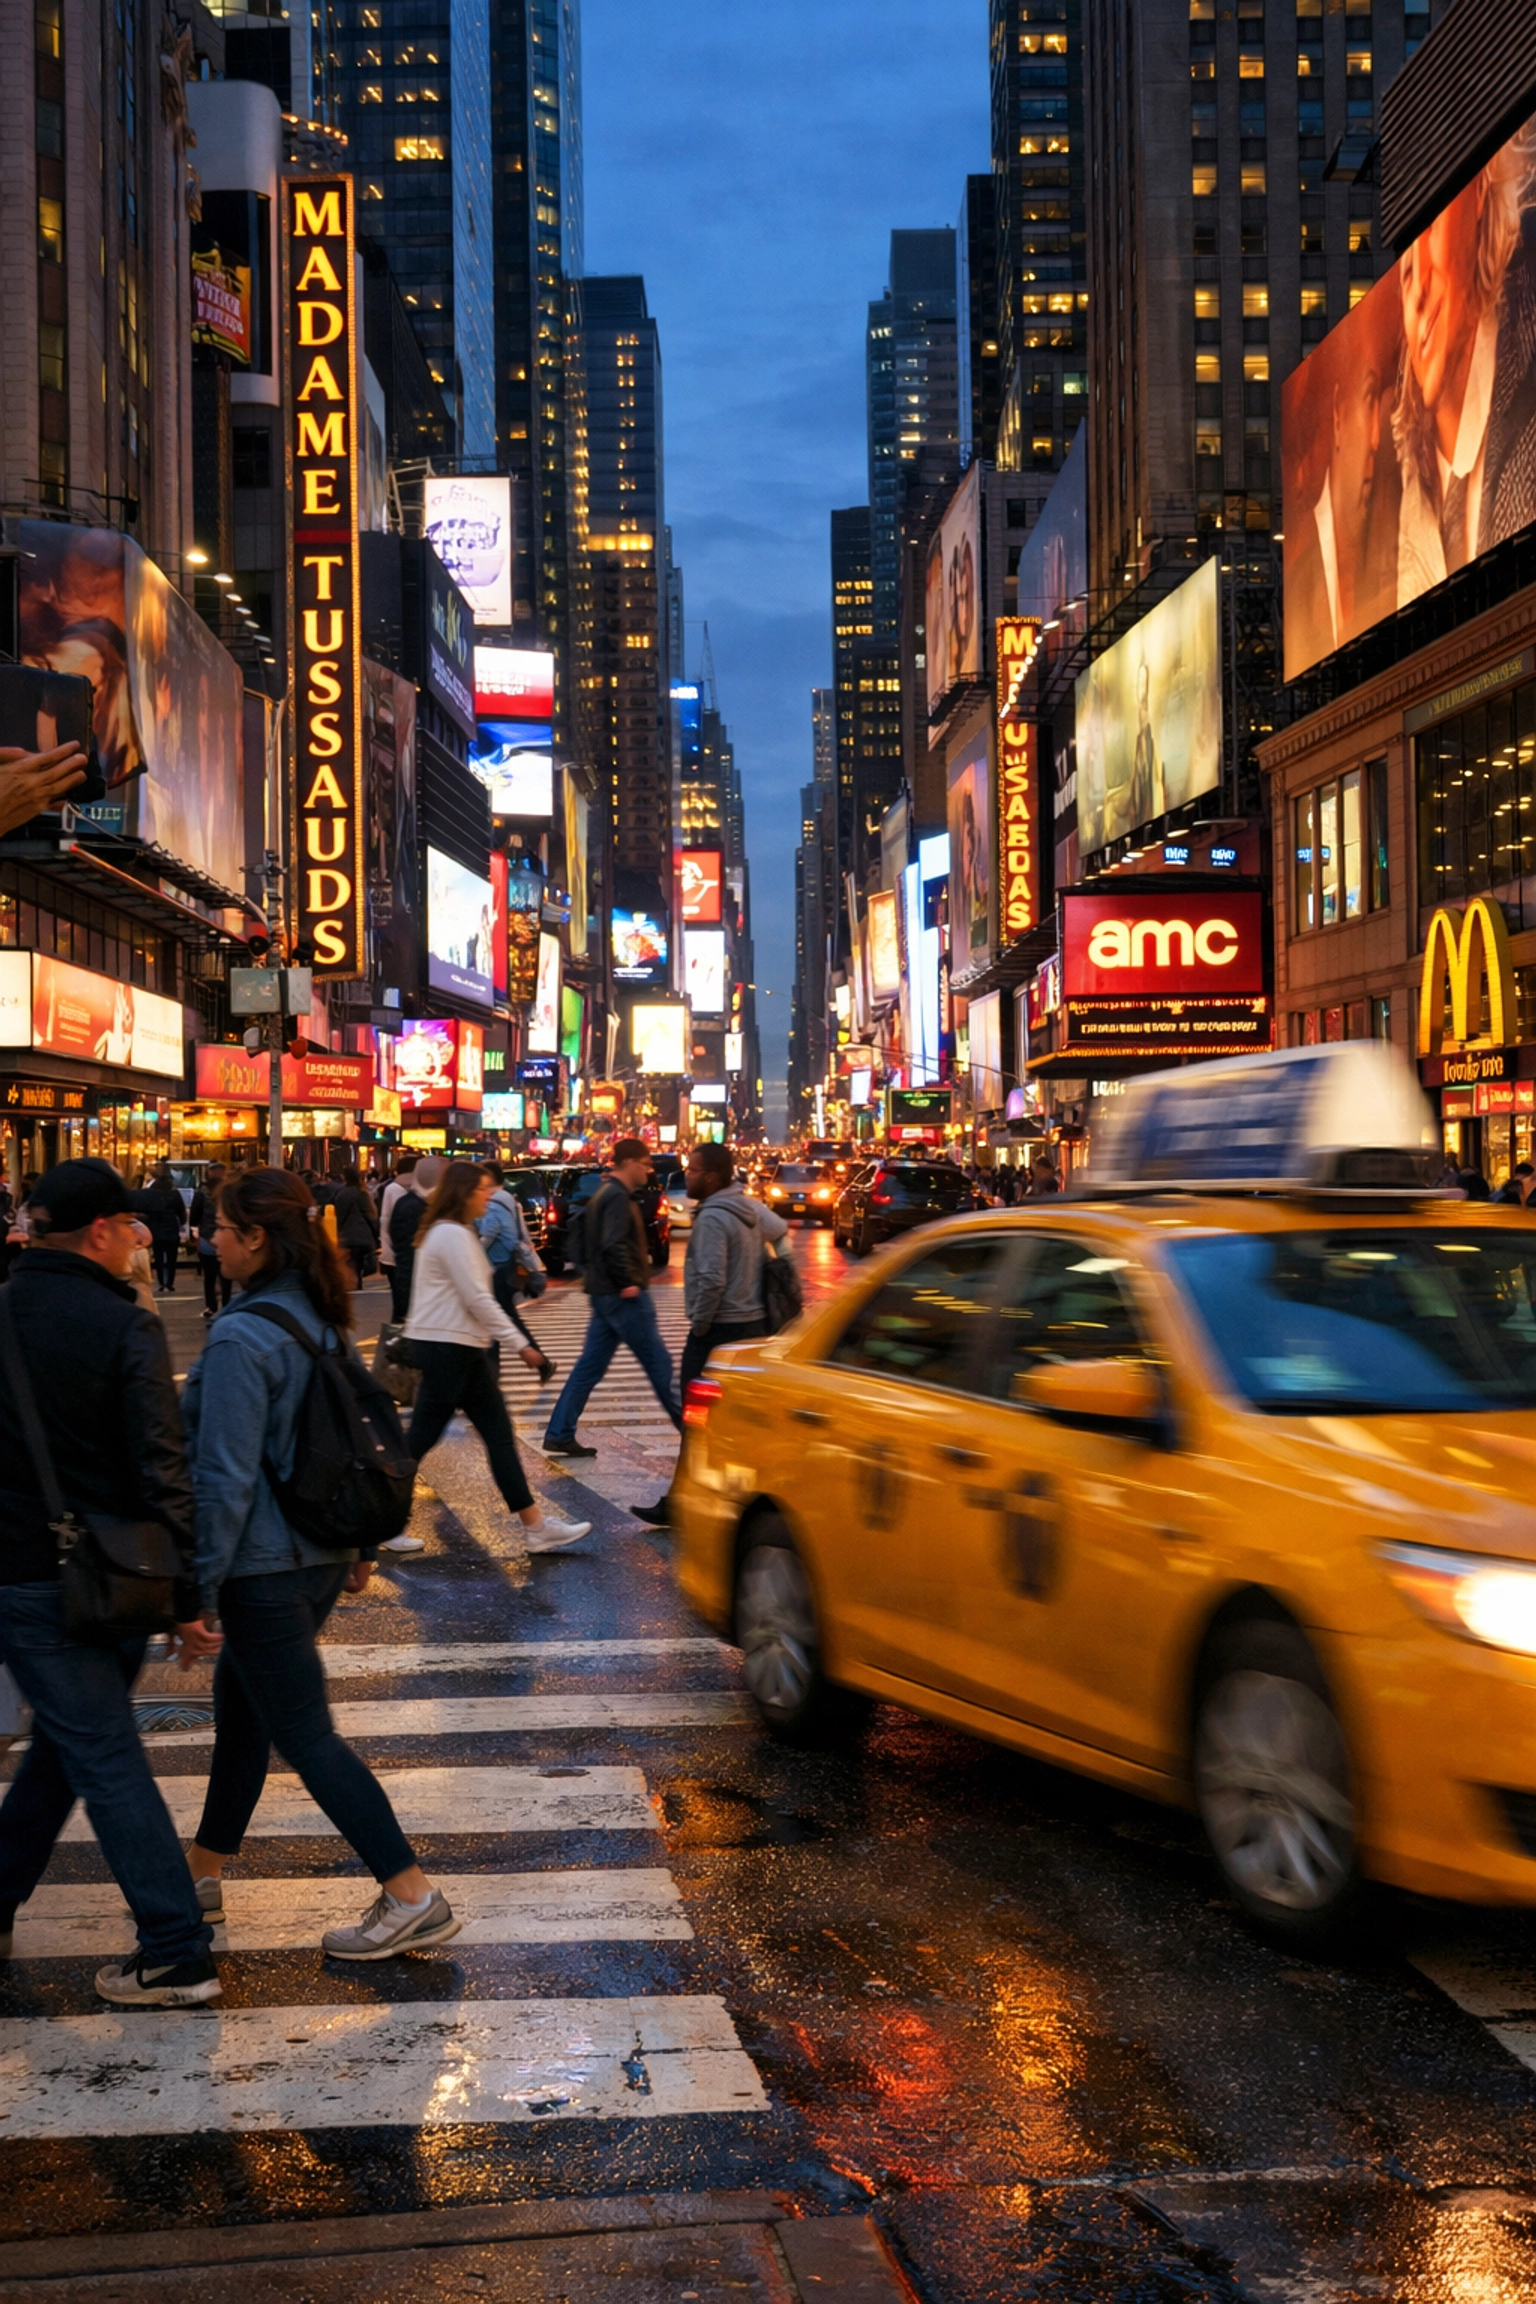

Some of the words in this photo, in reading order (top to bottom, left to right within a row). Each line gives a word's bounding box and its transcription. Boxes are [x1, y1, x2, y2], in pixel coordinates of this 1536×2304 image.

[293, 191, 346, 515] MADAME
[303, 556, 351, 965] TUSSAUDS
[1087, 919, 1239, 969] amc
